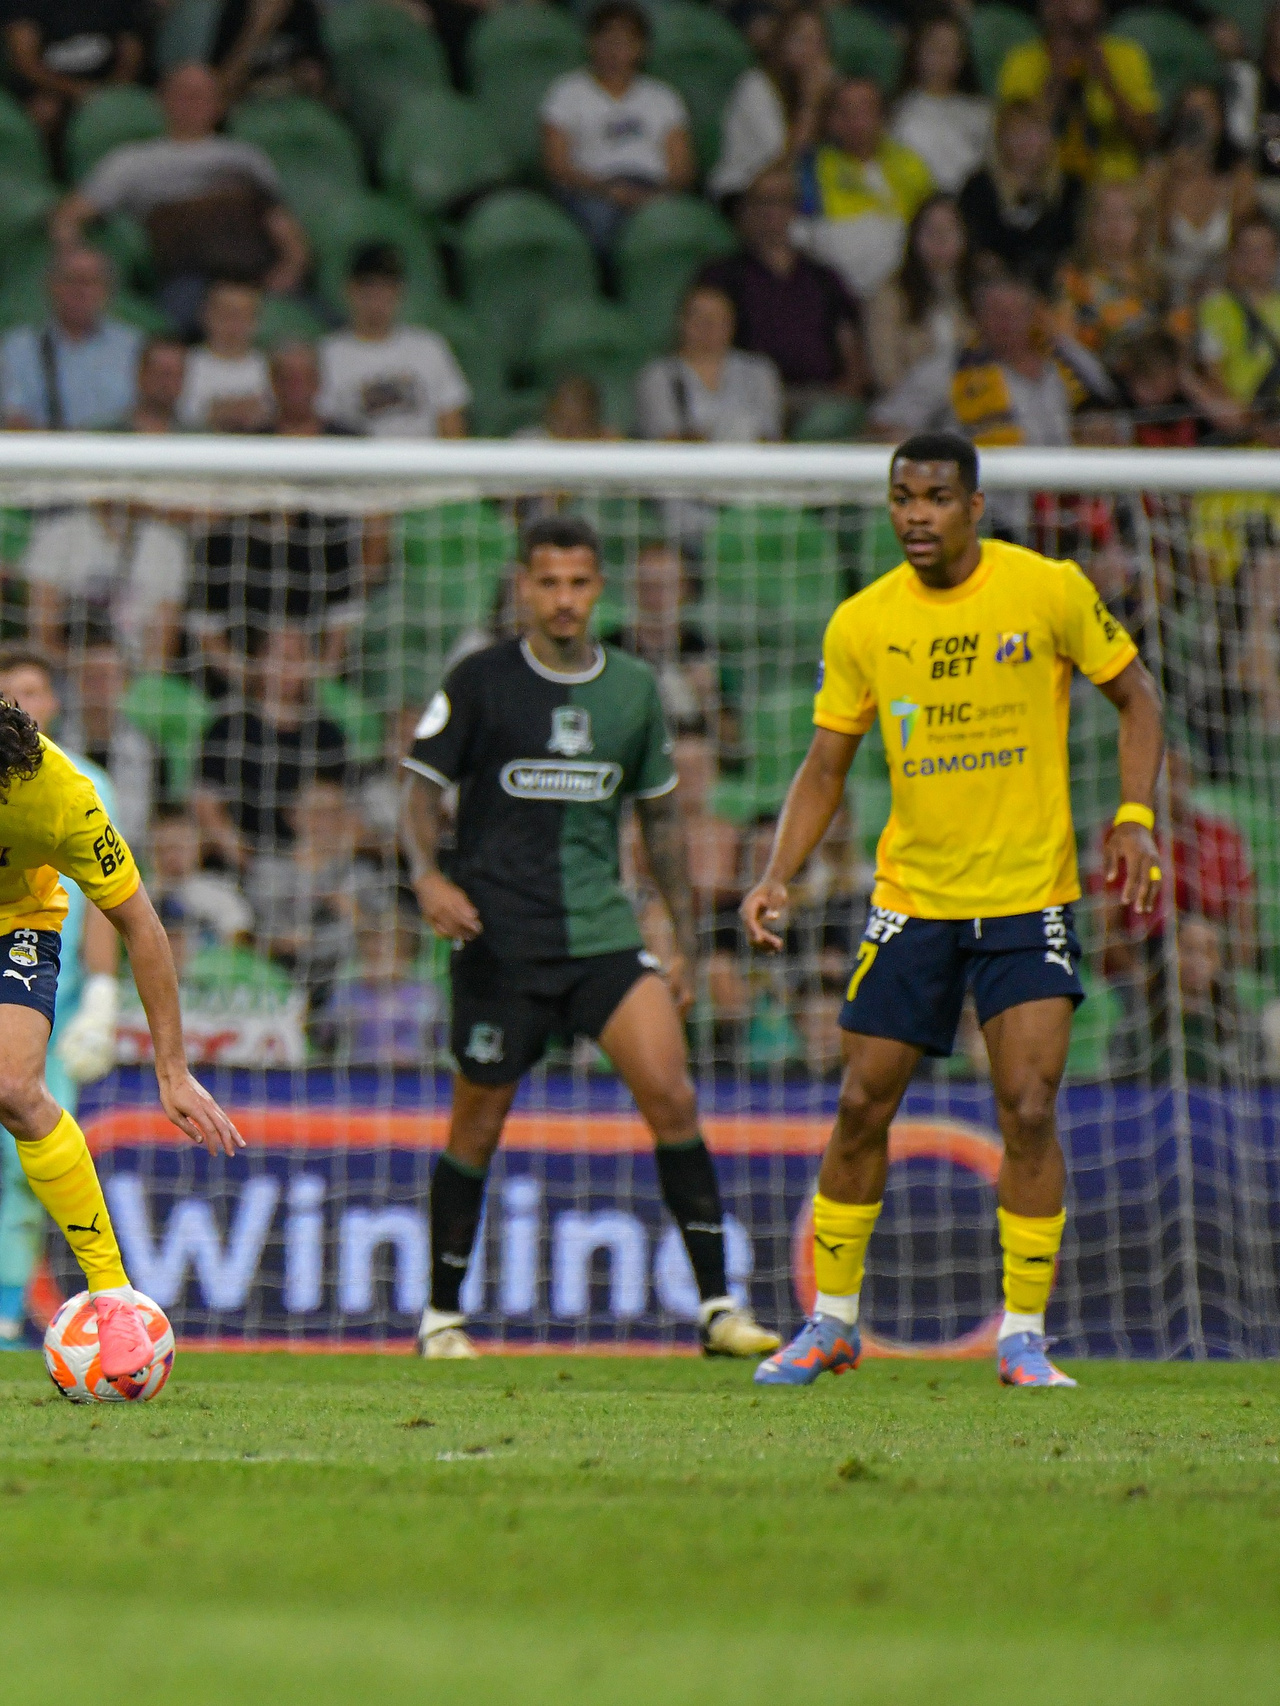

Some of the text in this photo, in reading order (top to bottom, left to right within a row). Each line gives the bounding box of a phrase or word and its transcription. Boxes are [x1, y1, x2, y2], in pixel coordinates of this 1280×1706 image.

[929, 633, 980, 657] FON
[930, 656, 977, 680] BET
[923, 702, 972, 727] ТНС
[903, 746, 1027, 778] самолет
[93, 824, 116, 862] FO
[100, 841, 126, 878] BE
